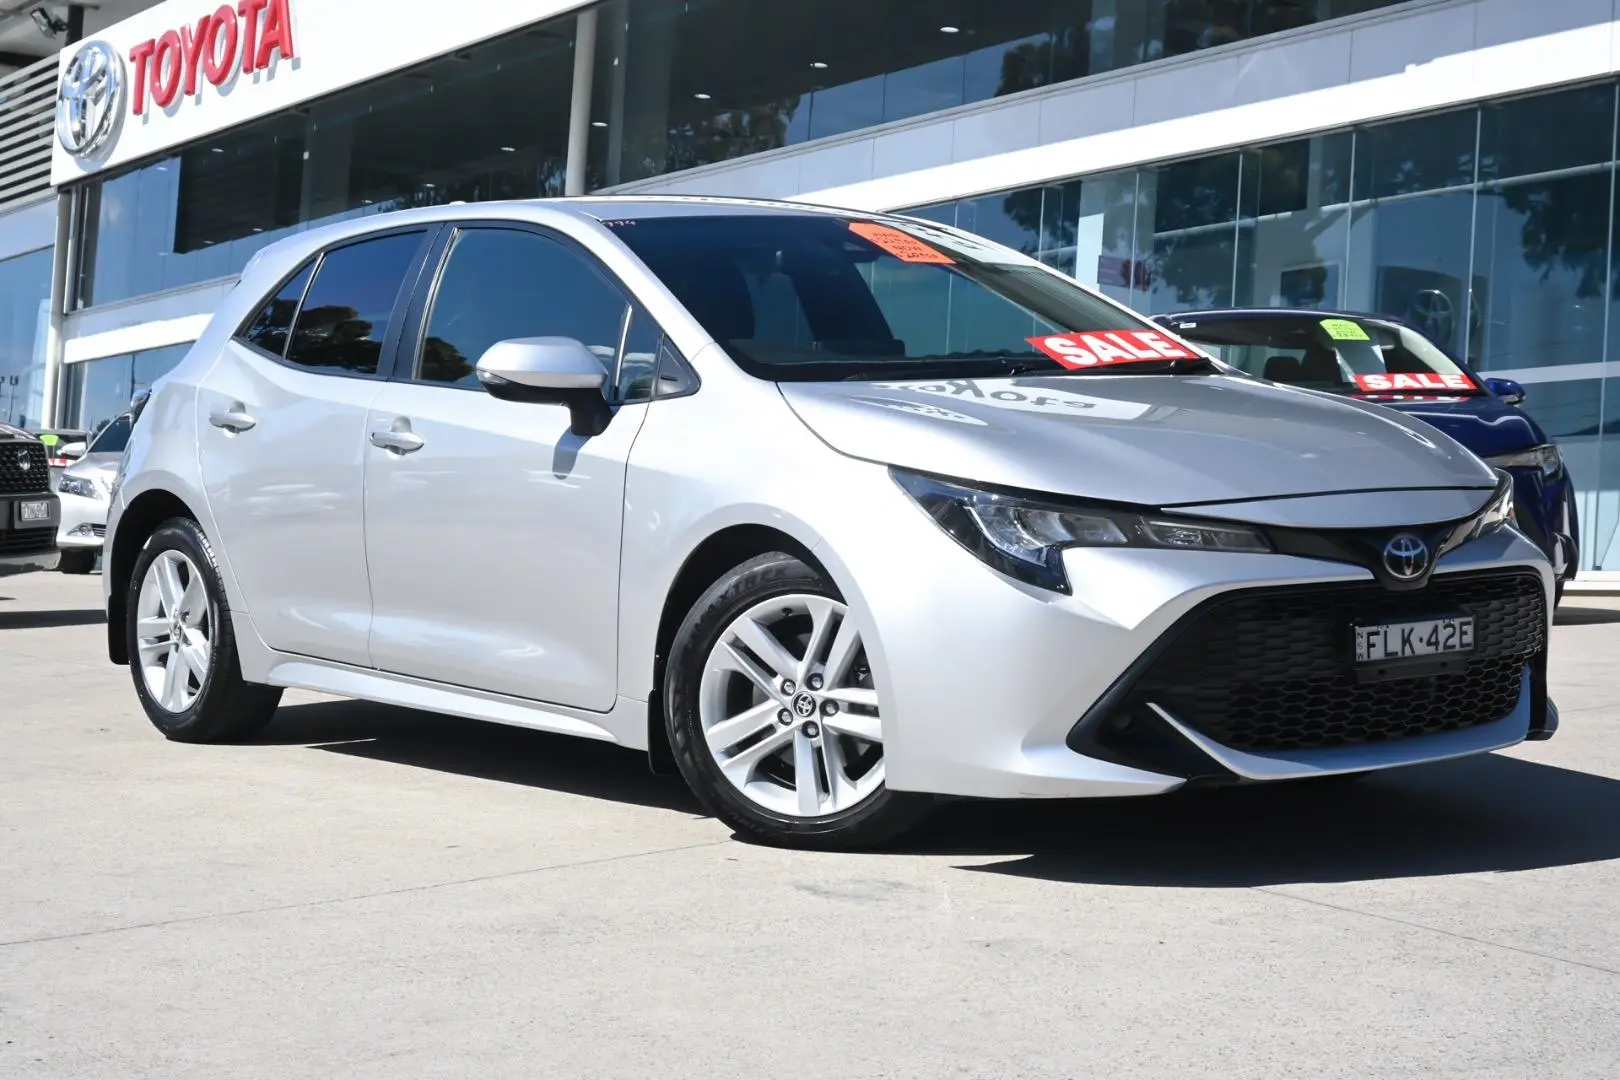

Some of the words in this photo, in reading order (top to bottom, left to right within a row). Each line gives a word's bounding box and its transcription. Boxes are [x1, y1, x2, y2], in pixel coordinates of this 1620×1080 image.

[129, 0, 294, 115] TOYOTA
[1044, 332, 1188, 366] SALE
[1362, 374, 1470, 390] SALE
